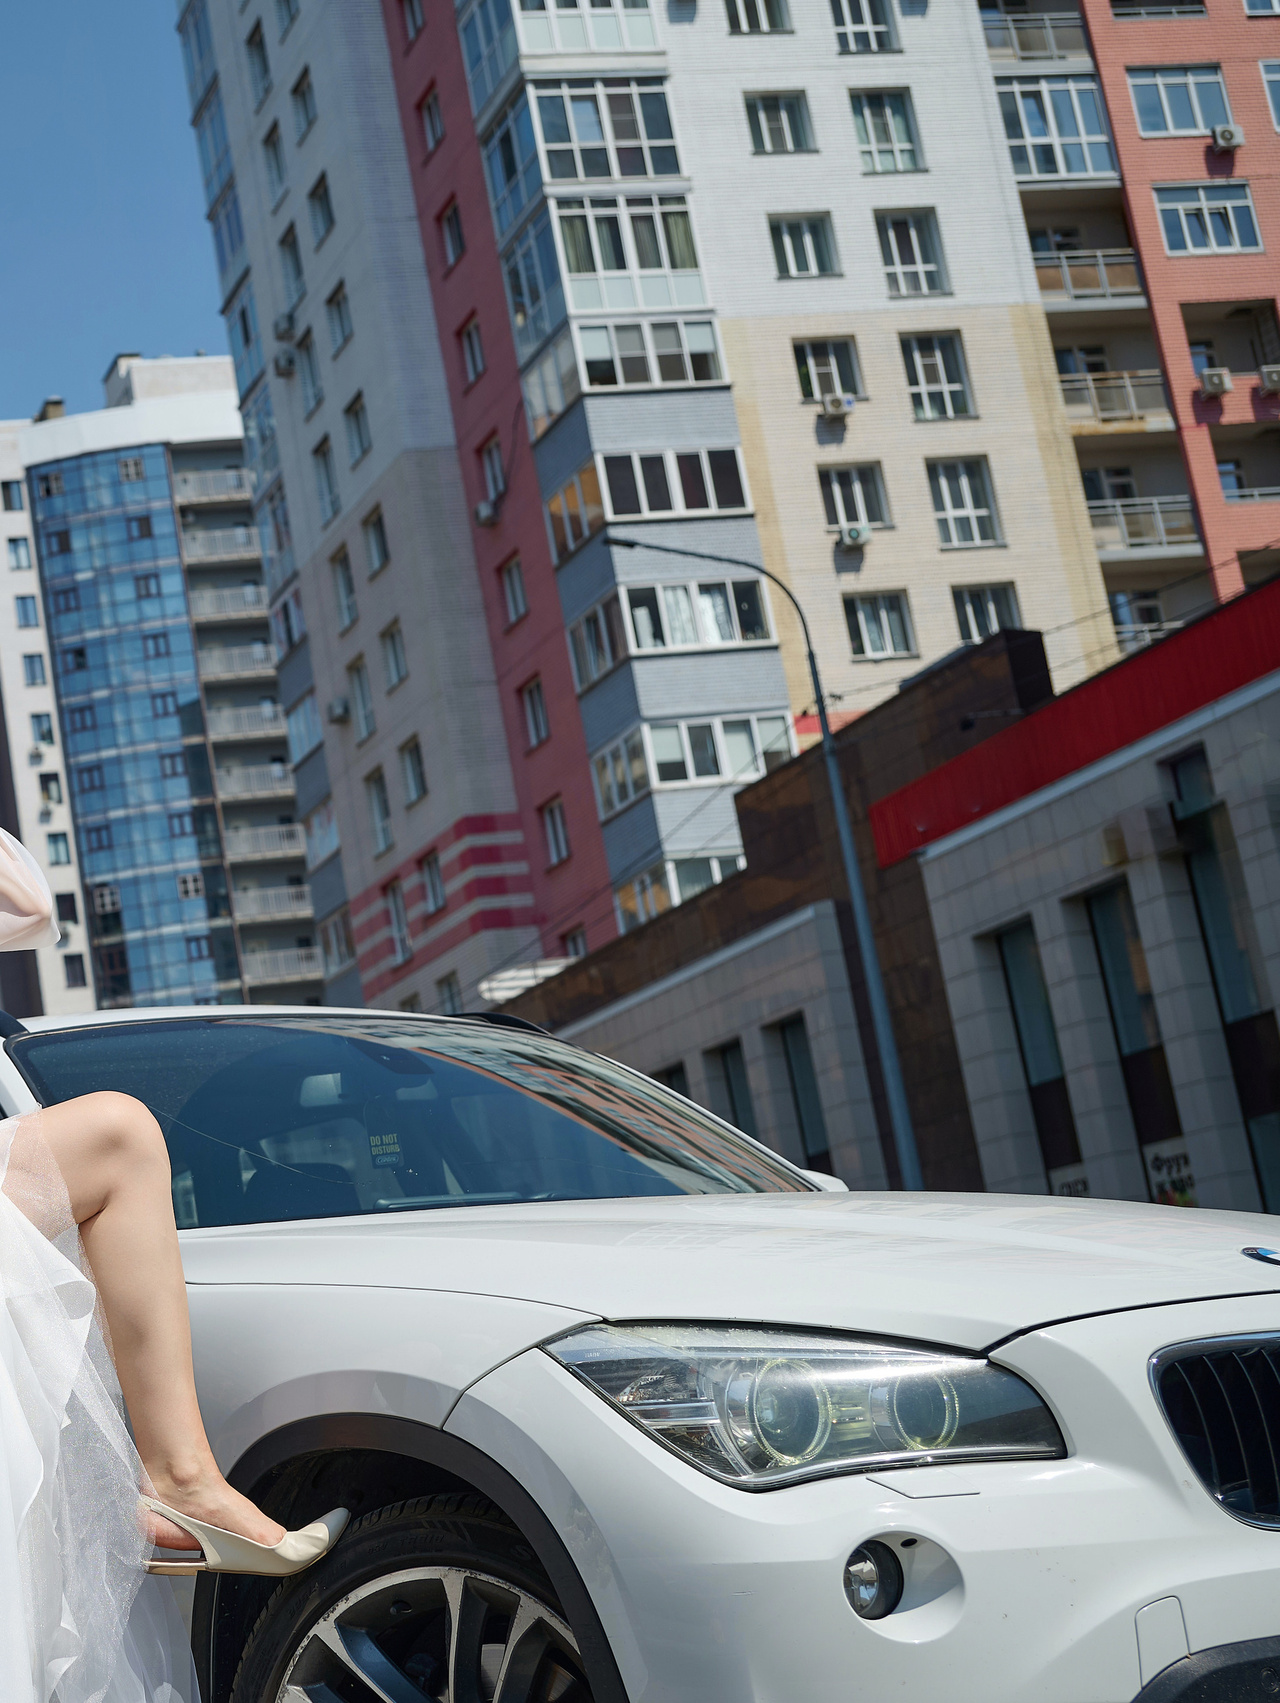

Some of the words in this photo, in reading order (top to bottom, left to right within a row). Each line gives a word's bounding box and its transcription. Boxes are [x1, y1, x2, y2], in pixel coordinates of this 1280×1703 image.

[369, 1135, 381, 1146] DO
[382, 1133, 398, 1144] NOT
[371, 1144, 400, 1155] DISTURB
